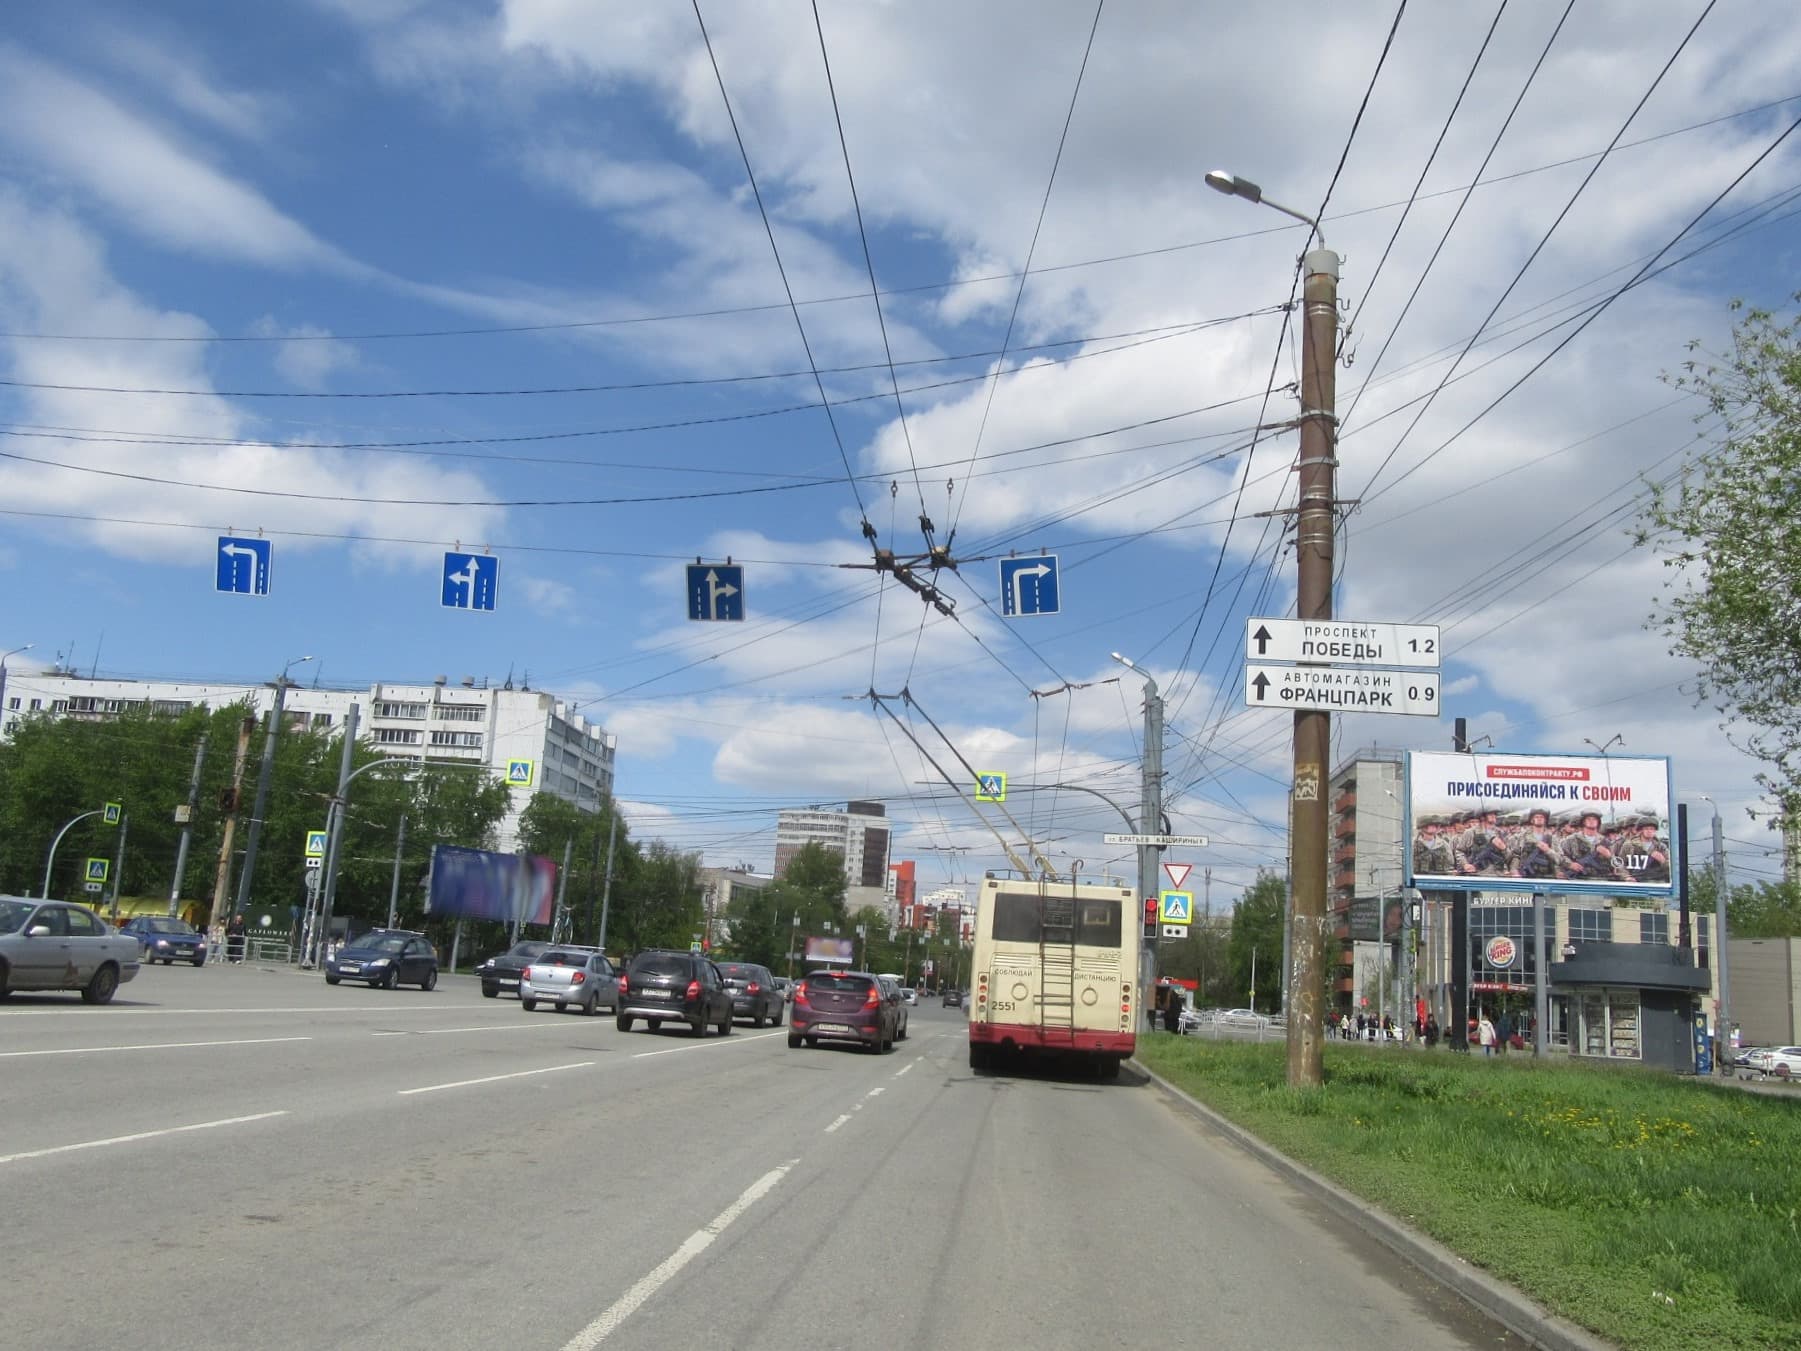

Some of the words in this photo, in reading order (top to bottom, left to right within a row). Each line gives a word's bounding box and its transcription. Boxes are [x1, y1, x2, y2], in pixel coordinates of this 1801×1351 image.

[1304, 626, 1377, 639] ПРОСПЕКТ
[1302, 641, 1382, 660] ПОБЕДЫ
[1407, 638, 1435, 654] 1.2
[1284, 672, 1392, 687] АВТОМАГАЗИН
[1279, 687, 1393, 707] ФРАНЦПАРК
[1407, 686, 1435, 701] 0.9
[1447, 780, 1566, 800] ПРИСОЕДИНЯЙСЯ
[1570, 785, 1579, 800] К
[1582, 785, 1632, 802] СВОИМ
[1625, 854, 1649, 870] 117
[1473, 896, 1506, 905] БУРГЕР
[1490, 946, 1513, 960] KING
[994, 968, 1033, 977] СОБЛЮДАЙ
[1074, 973, 1117, 982] ДИСТАНЦИЮ
[991, 1000, 1016, 1011] 2551
